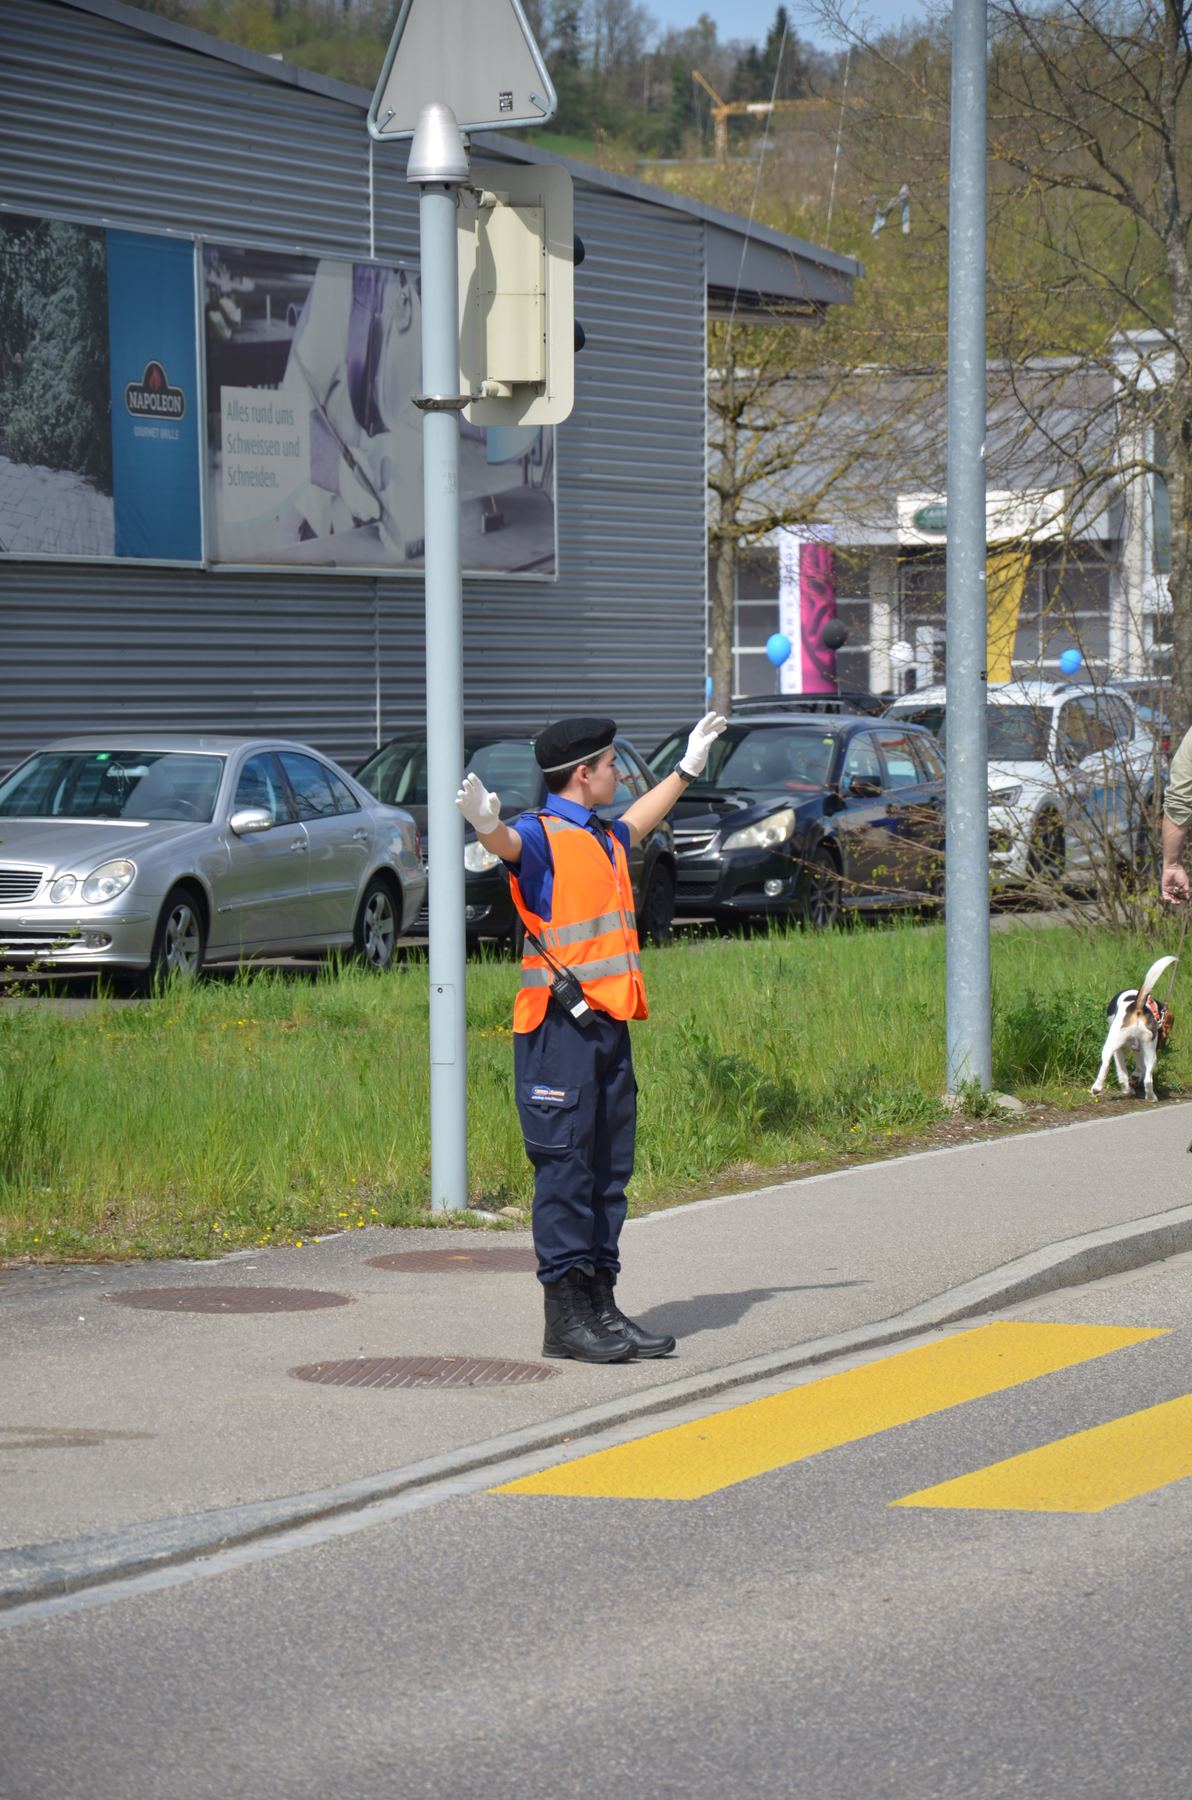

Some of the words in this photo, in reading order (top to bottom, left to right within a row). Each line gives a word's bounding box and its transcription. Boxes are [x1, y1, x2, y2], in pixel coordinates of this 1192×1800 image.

[129, 391, 181, 413] NAPOLEON
[226, 399, 249, 422] Alles
[252, 402, 273, 424] rund
[275, 408, 295, 426] ums
[226, 431, 280, 456] Schweissen
[282, 435, 300, 458] und
[226, 464, 280, 488] Schneiden.
